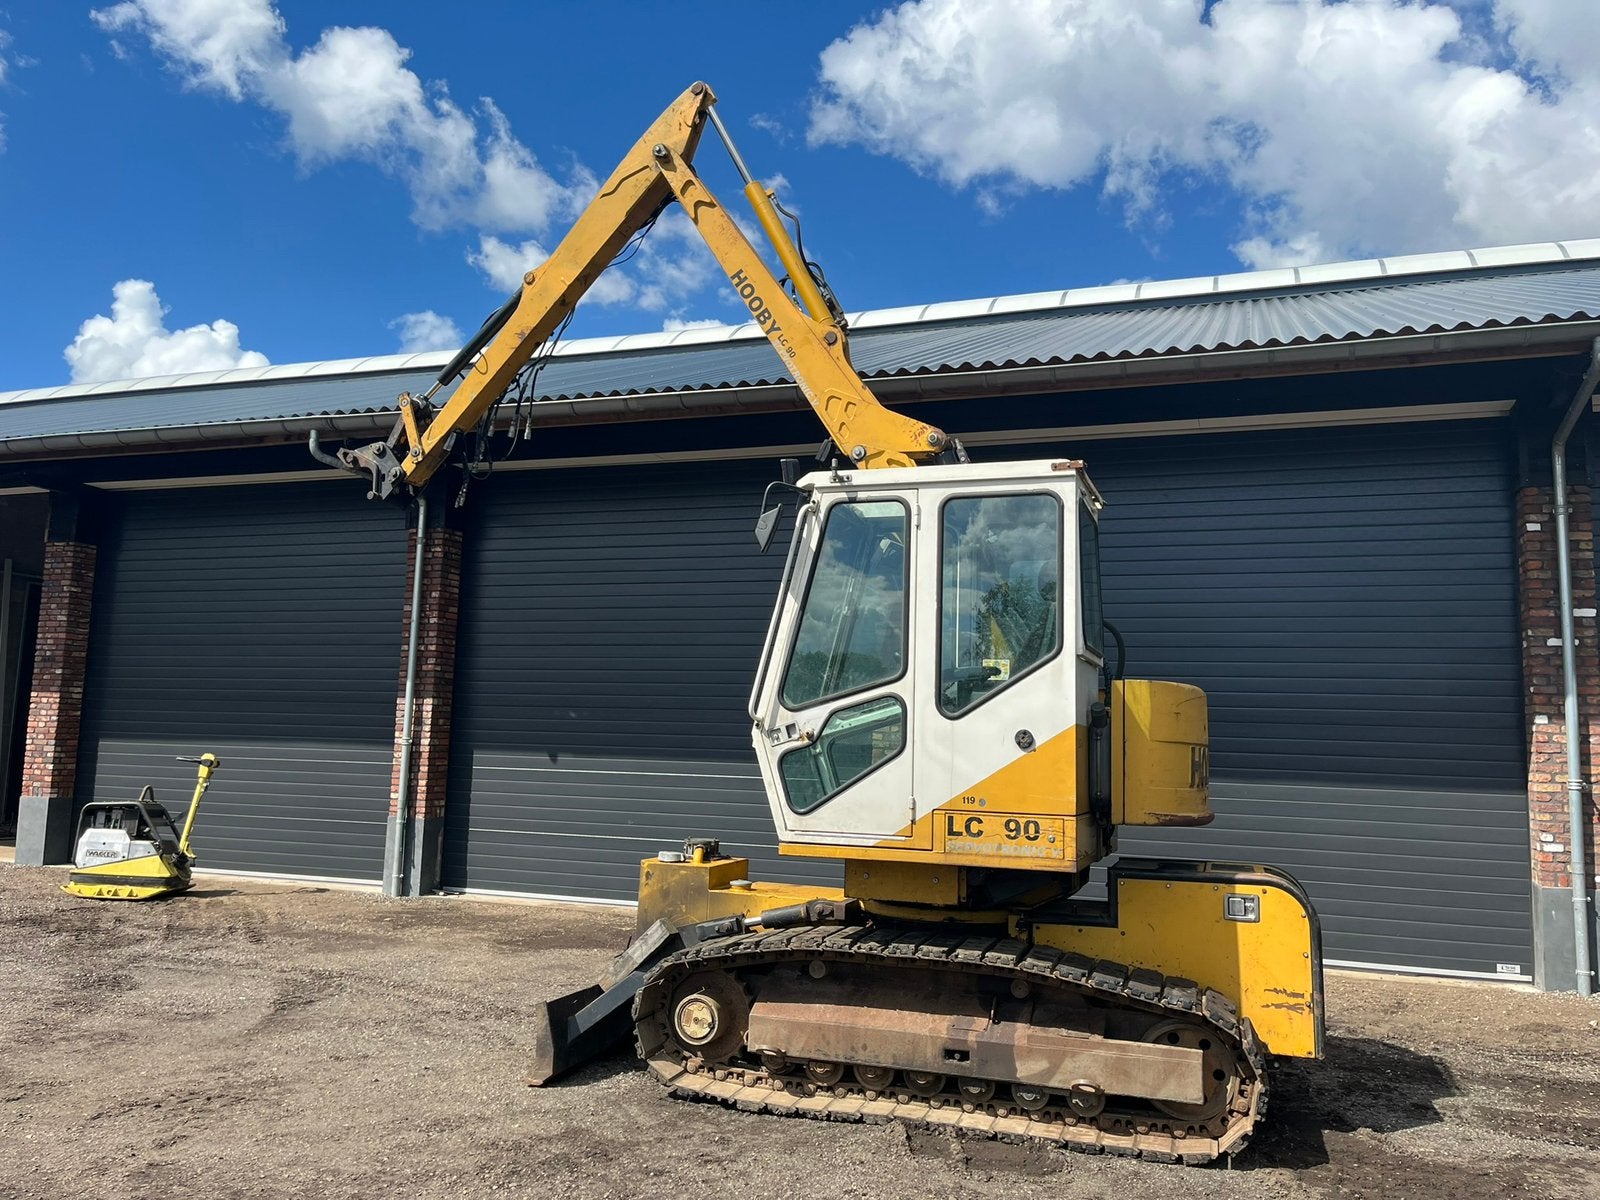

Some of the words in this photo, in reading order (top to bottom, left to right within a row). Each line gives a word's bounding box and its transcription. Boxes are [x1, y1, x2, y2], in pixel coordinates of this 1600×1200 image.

[730, 268, 782, 335] HOOBY
[777, 333, 789, 347] LC
[785, 346, 797, 359] 90
[962, 796, 976, 805] 119
[946, 815, 984, 838] LC
[1004, 818, 1041, 842] 90
